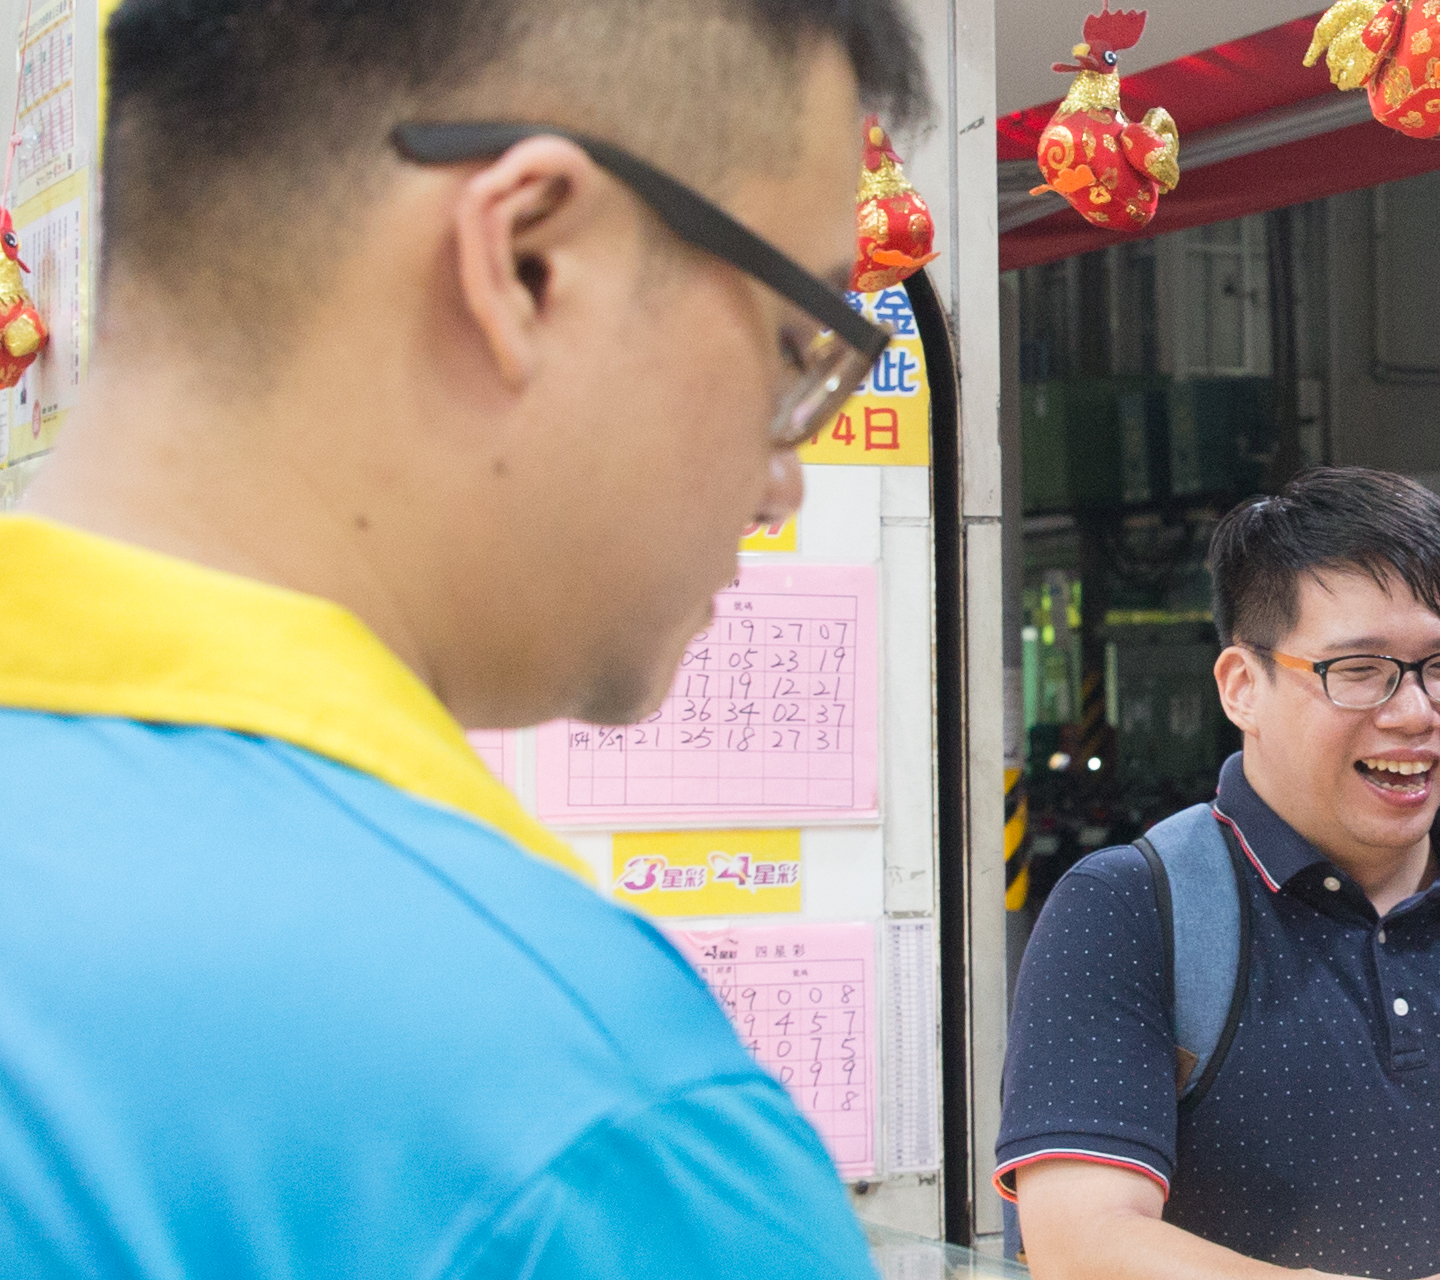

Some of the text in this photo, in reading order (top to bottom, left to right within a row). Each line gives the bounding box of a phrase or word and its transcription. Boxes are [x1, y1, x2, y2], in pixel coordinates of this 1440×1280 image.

[728, 619, 848, 644] 19 27 07
[680, 646, 846, 672] 04 05 23 19
[685, 671, 841, 702] 17 19 12 21
[681, 697, 846, 728] 36 34 02 37
[634, 727, 660, 747] 21
[680, 726, 714, 749] 25
[728, 726, 755, 752] 18
[771, 729, 801, 750] 27
[817, 729, 841, 750] 31
[755, 943, 805, 958] 四星彩
[741, 987, 756, 1011] 9
[777, 989, 792, 1005] 0
[809, 987, 822, 1004] 0
[841, 984, 855, 1004] 8
[744, 1011, 856, 1038] 9 4 5 7
[776, 1040, 792, 1058] 0
[810, 1037, 822, 1062] 7
[841, 1037, 856, 1061] 5
[810, 1061, 822, 1087] 9
[843, 1059, 856, 1085] 9
[841, 1091, 859, 1111] 8
